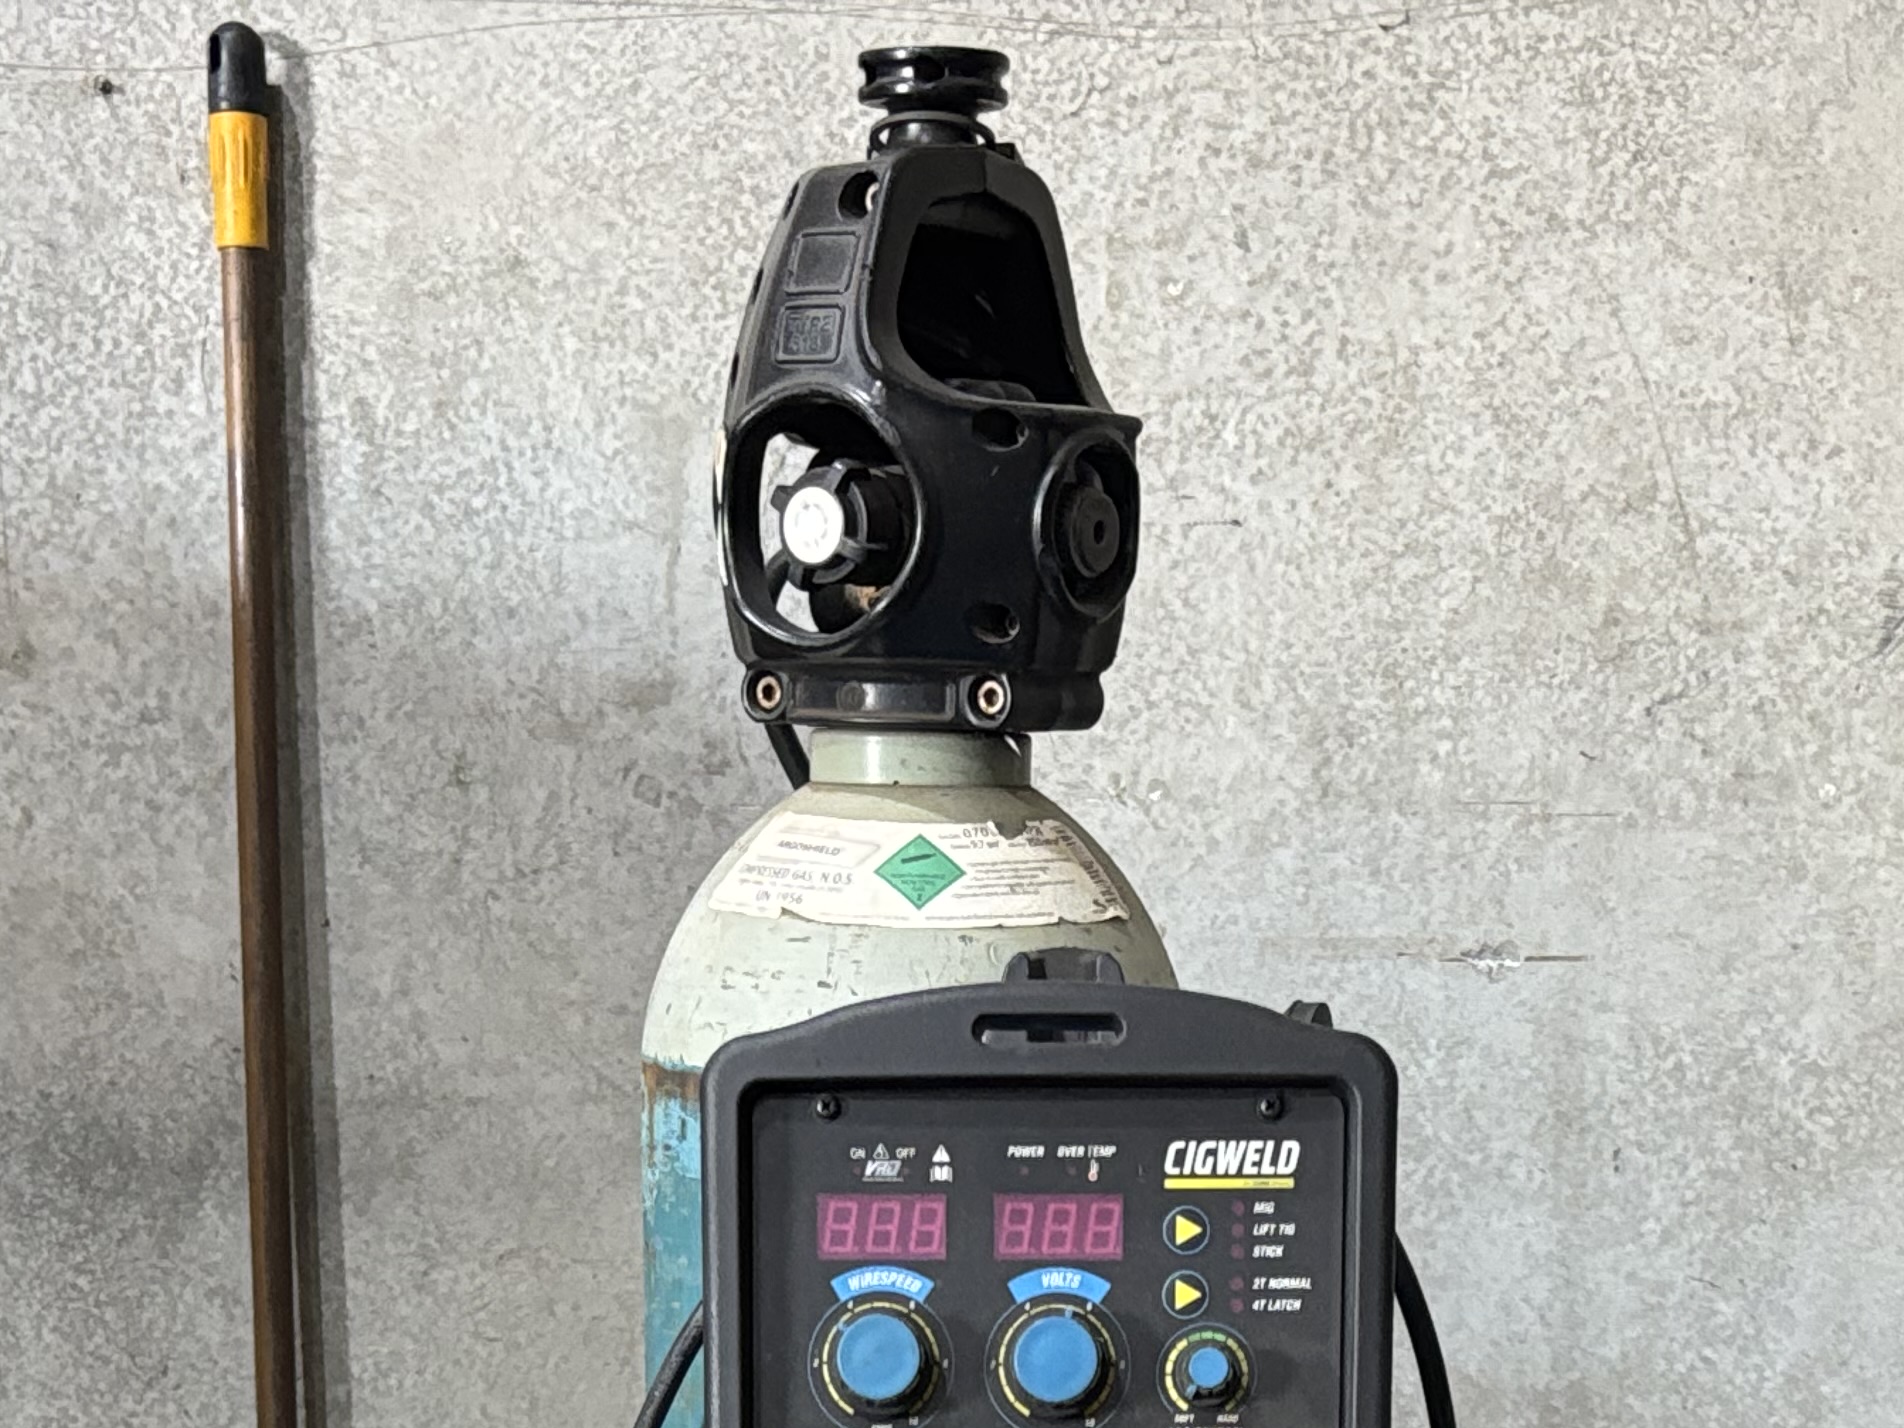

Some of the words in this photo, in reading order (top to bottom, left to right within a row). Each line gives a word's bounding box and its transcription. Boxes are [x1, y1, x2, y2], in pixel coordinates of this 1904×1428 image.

[792, 870, 813, 882] GAS
[850, 1147, 866, 1159] ON
[896, 1147, 917, 1159] OFF
[1007, 1145, 1045, 1158] POWER
[1056, 1145, 1085, 1158] OVER
[1087, 1145, 1116, 1158] TEMP
[1164, 1139, 1301, 1175] CIGWELD
[1252, 1223, 1277, 1236] LIFT
[1279, 1223, 1296, 1236] TIG
[1252, 1244, 1284, 1258] STICK
[847, 1271, 923, 1293] WIRESPEED
[1041, 1271, 1082, 1289] VOLTS
[1252, 1277, 1267, 1290] 2T
[1268, 1277, 1312, 1290] NORMAL
[1252, 1299, 1267, 1312] 4T
[1268, 1299, 1302, 1312] LATCH
